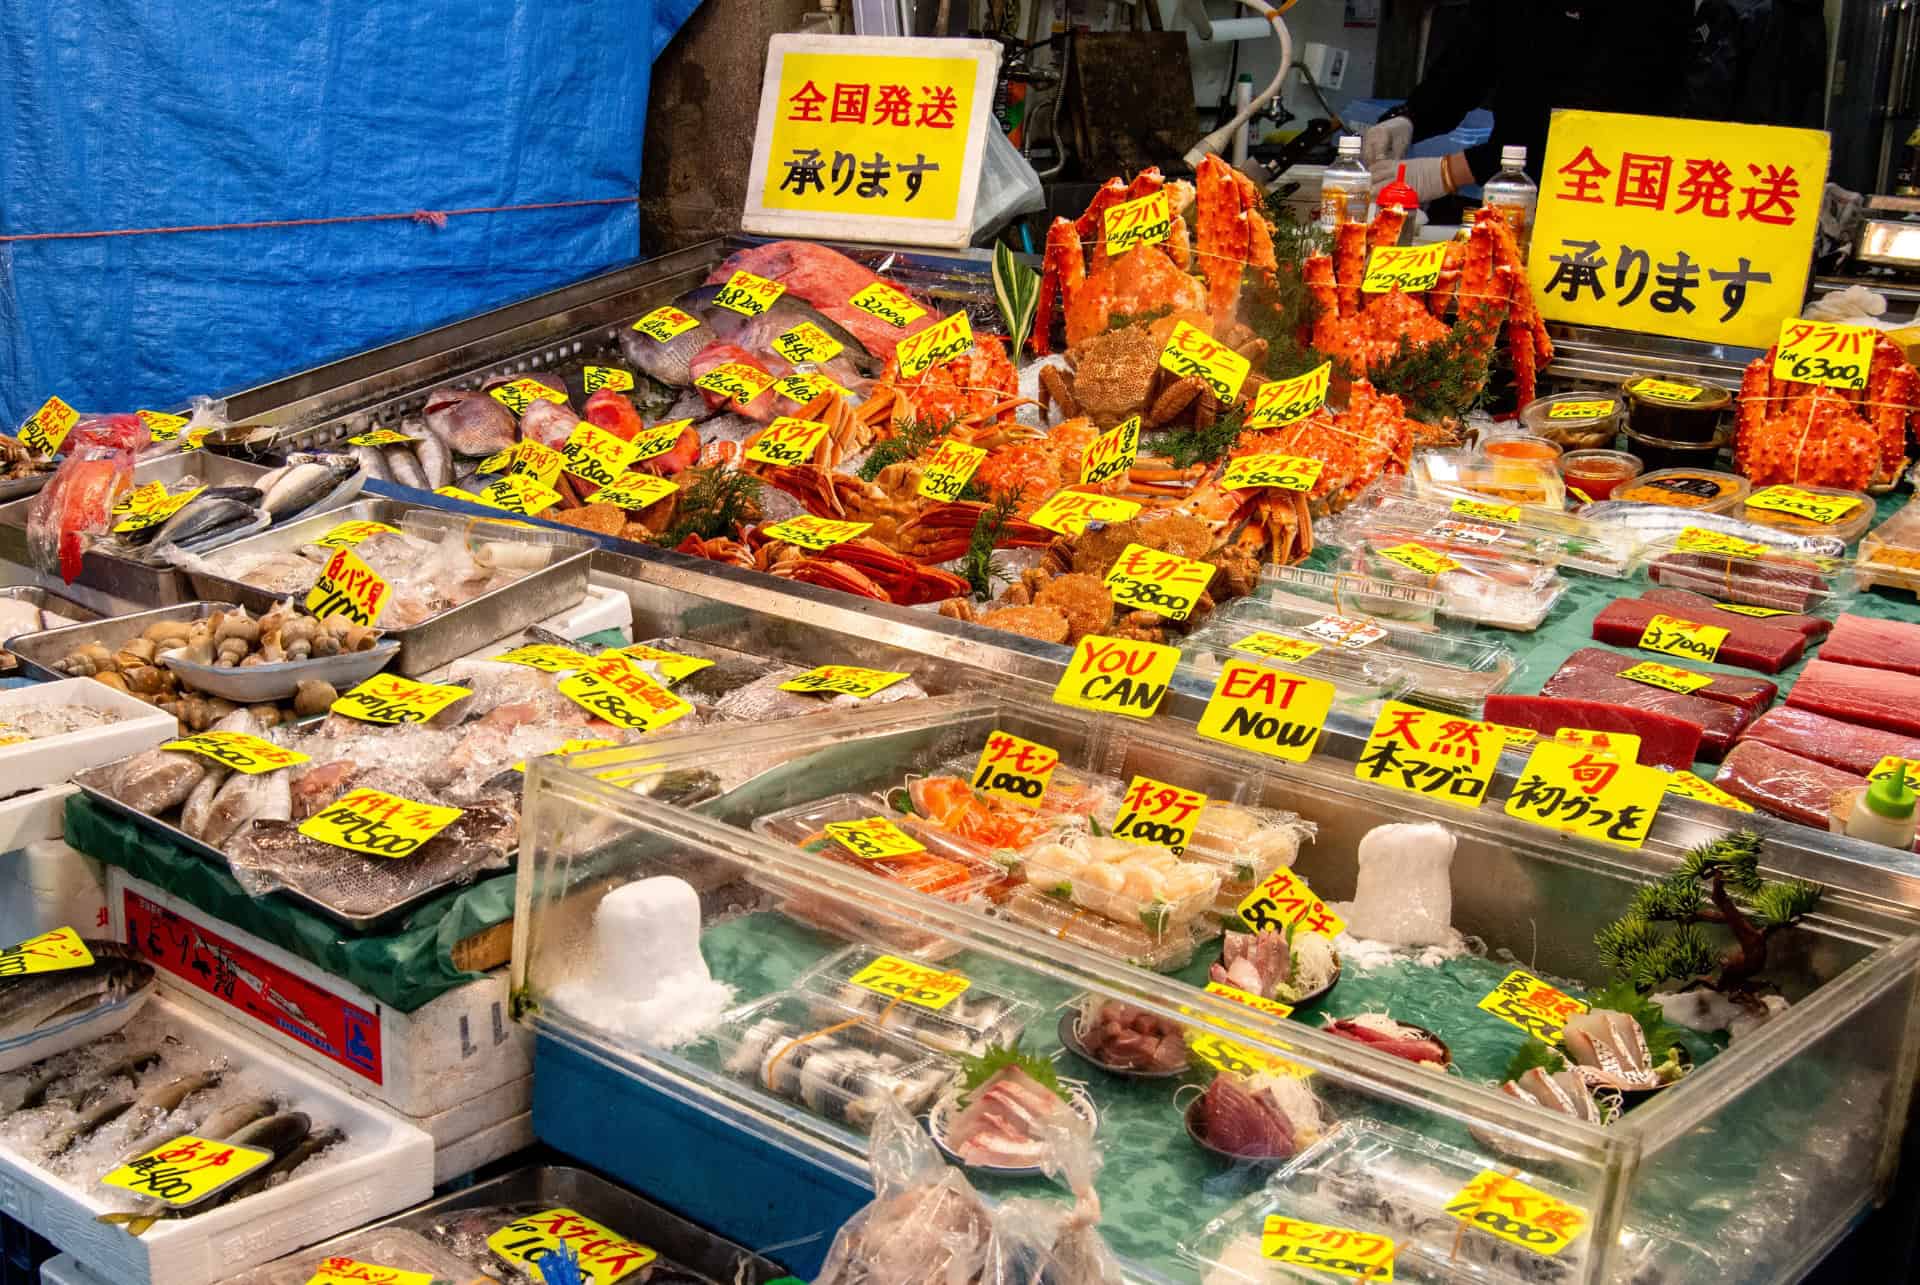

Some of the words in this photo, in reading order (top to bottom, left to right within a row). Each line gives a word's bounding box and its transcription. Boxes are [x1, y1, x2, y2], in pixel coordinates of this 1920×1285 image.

[788, 80, 957, 128] 全国発送
[780, 149, 939, 202] 承ります
[1556, 146, 1800, 226] 全国発送
[1106, 192, 1165, 231] タラバ
[1373, 244, 1447, 271] タラバ
[1544, 239, 1771, 323] 承ります
[901, 313, 966, 360] タラバ
[1783, 324, 1875, 355] タラバ
[1259, 362, 1330, 410] タラバ
[762, 420, 823, 447] ズワイ
[1120, 549, 1204, 584] 毛ガニ
[1079, 642, 1157, 675] YOU
[1081, 675, 1165, 709] CAN
[1221, 668, 1306, 709] EAT
[1221, 707, 1318, 747] NOW
[1376, 710, 1493, 764] 天然
[989, 736, 1056, 775] サーモン
[1360, 740, 1485, 797] 本マグロ
[1568, 755, 1620, 794] 旬
[1123, 782, 1199, 823] ホタテ
[1264, 873, 1336, 933] カンパチ
[158, 1141, 236, 1171] あゆ
[1266, 1220, 1386, 1257] エンガワ
